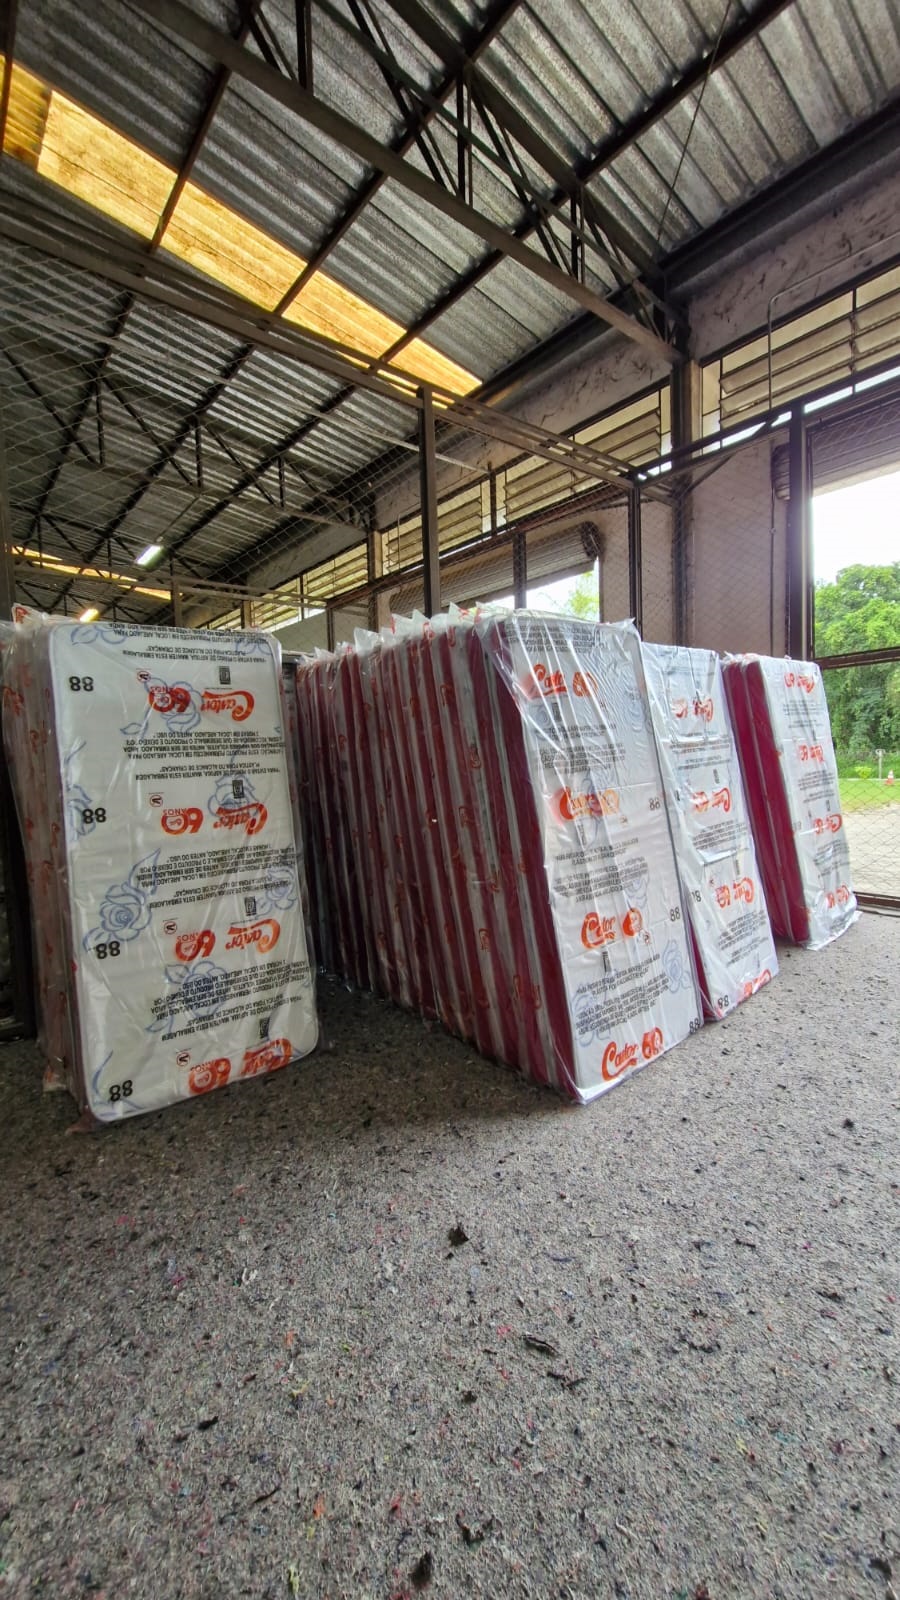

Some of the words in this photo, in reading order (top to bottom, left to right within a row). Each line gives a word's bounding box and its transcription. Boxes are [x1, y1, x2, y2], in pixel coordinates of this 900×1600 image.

[69, 676, 94, 692] 88
[149, 687, 190, 712] 60
[201, 691, 255, 722] Castor
[82, 807, 106, 824] 88
[163, 808, 187, 817] ANOS
[161, 808, 204, 836] 60
[213, 803, 268, 836] Castor
[178, 859, 202, 868] PRODUTO
[203, 864, 218, 872] ANTES
[140, 866, 151, 874] POR
[157, 876, 180, 885] AREJADO
[182, 873, 198, 881] LOCAL
[174, 887, 201, 898] CRIANÇAS"
[149, 896, 182, 908] EMBALAGEM
[183, 894, 196, 903] ESTA
[670, 906, 681, 922] 88
[226, 919, 281, 954] Castor
[96, 940, 121, 960] 88
[175, 929, 216, 961] 60
[244, 965, 259, 975] LOCAL
[267, 960, 282, 969] HORAS
[203, 976, 218, 986] ANTES
[249, 972, 258, 980] QUE
[190, 982, 214, 995] PRODUTO
[194, 979, 202, 987] DO
[197, 993, 207, 1002] SER
[212, 997, 219, 1005] EM
[718, 994, 730, 1010] 88
[151, 1003, 166, 1014] AINDA
[194, 999, 211, 1010] LOCAL
[253, 999, 265, 1008] FORA
[222, 1005, 244, 1016] ALCANCE
[689, 1017, 701, 1035] 88
[162, 1026, 195, 1042] EMBALAGEM
[602, 1041, 639, 1081] Castor
[642, 1027, 664, 1061] 60
[188, 1058, 232, 1096] 60
[109, 1079, 133, 1102] 88
